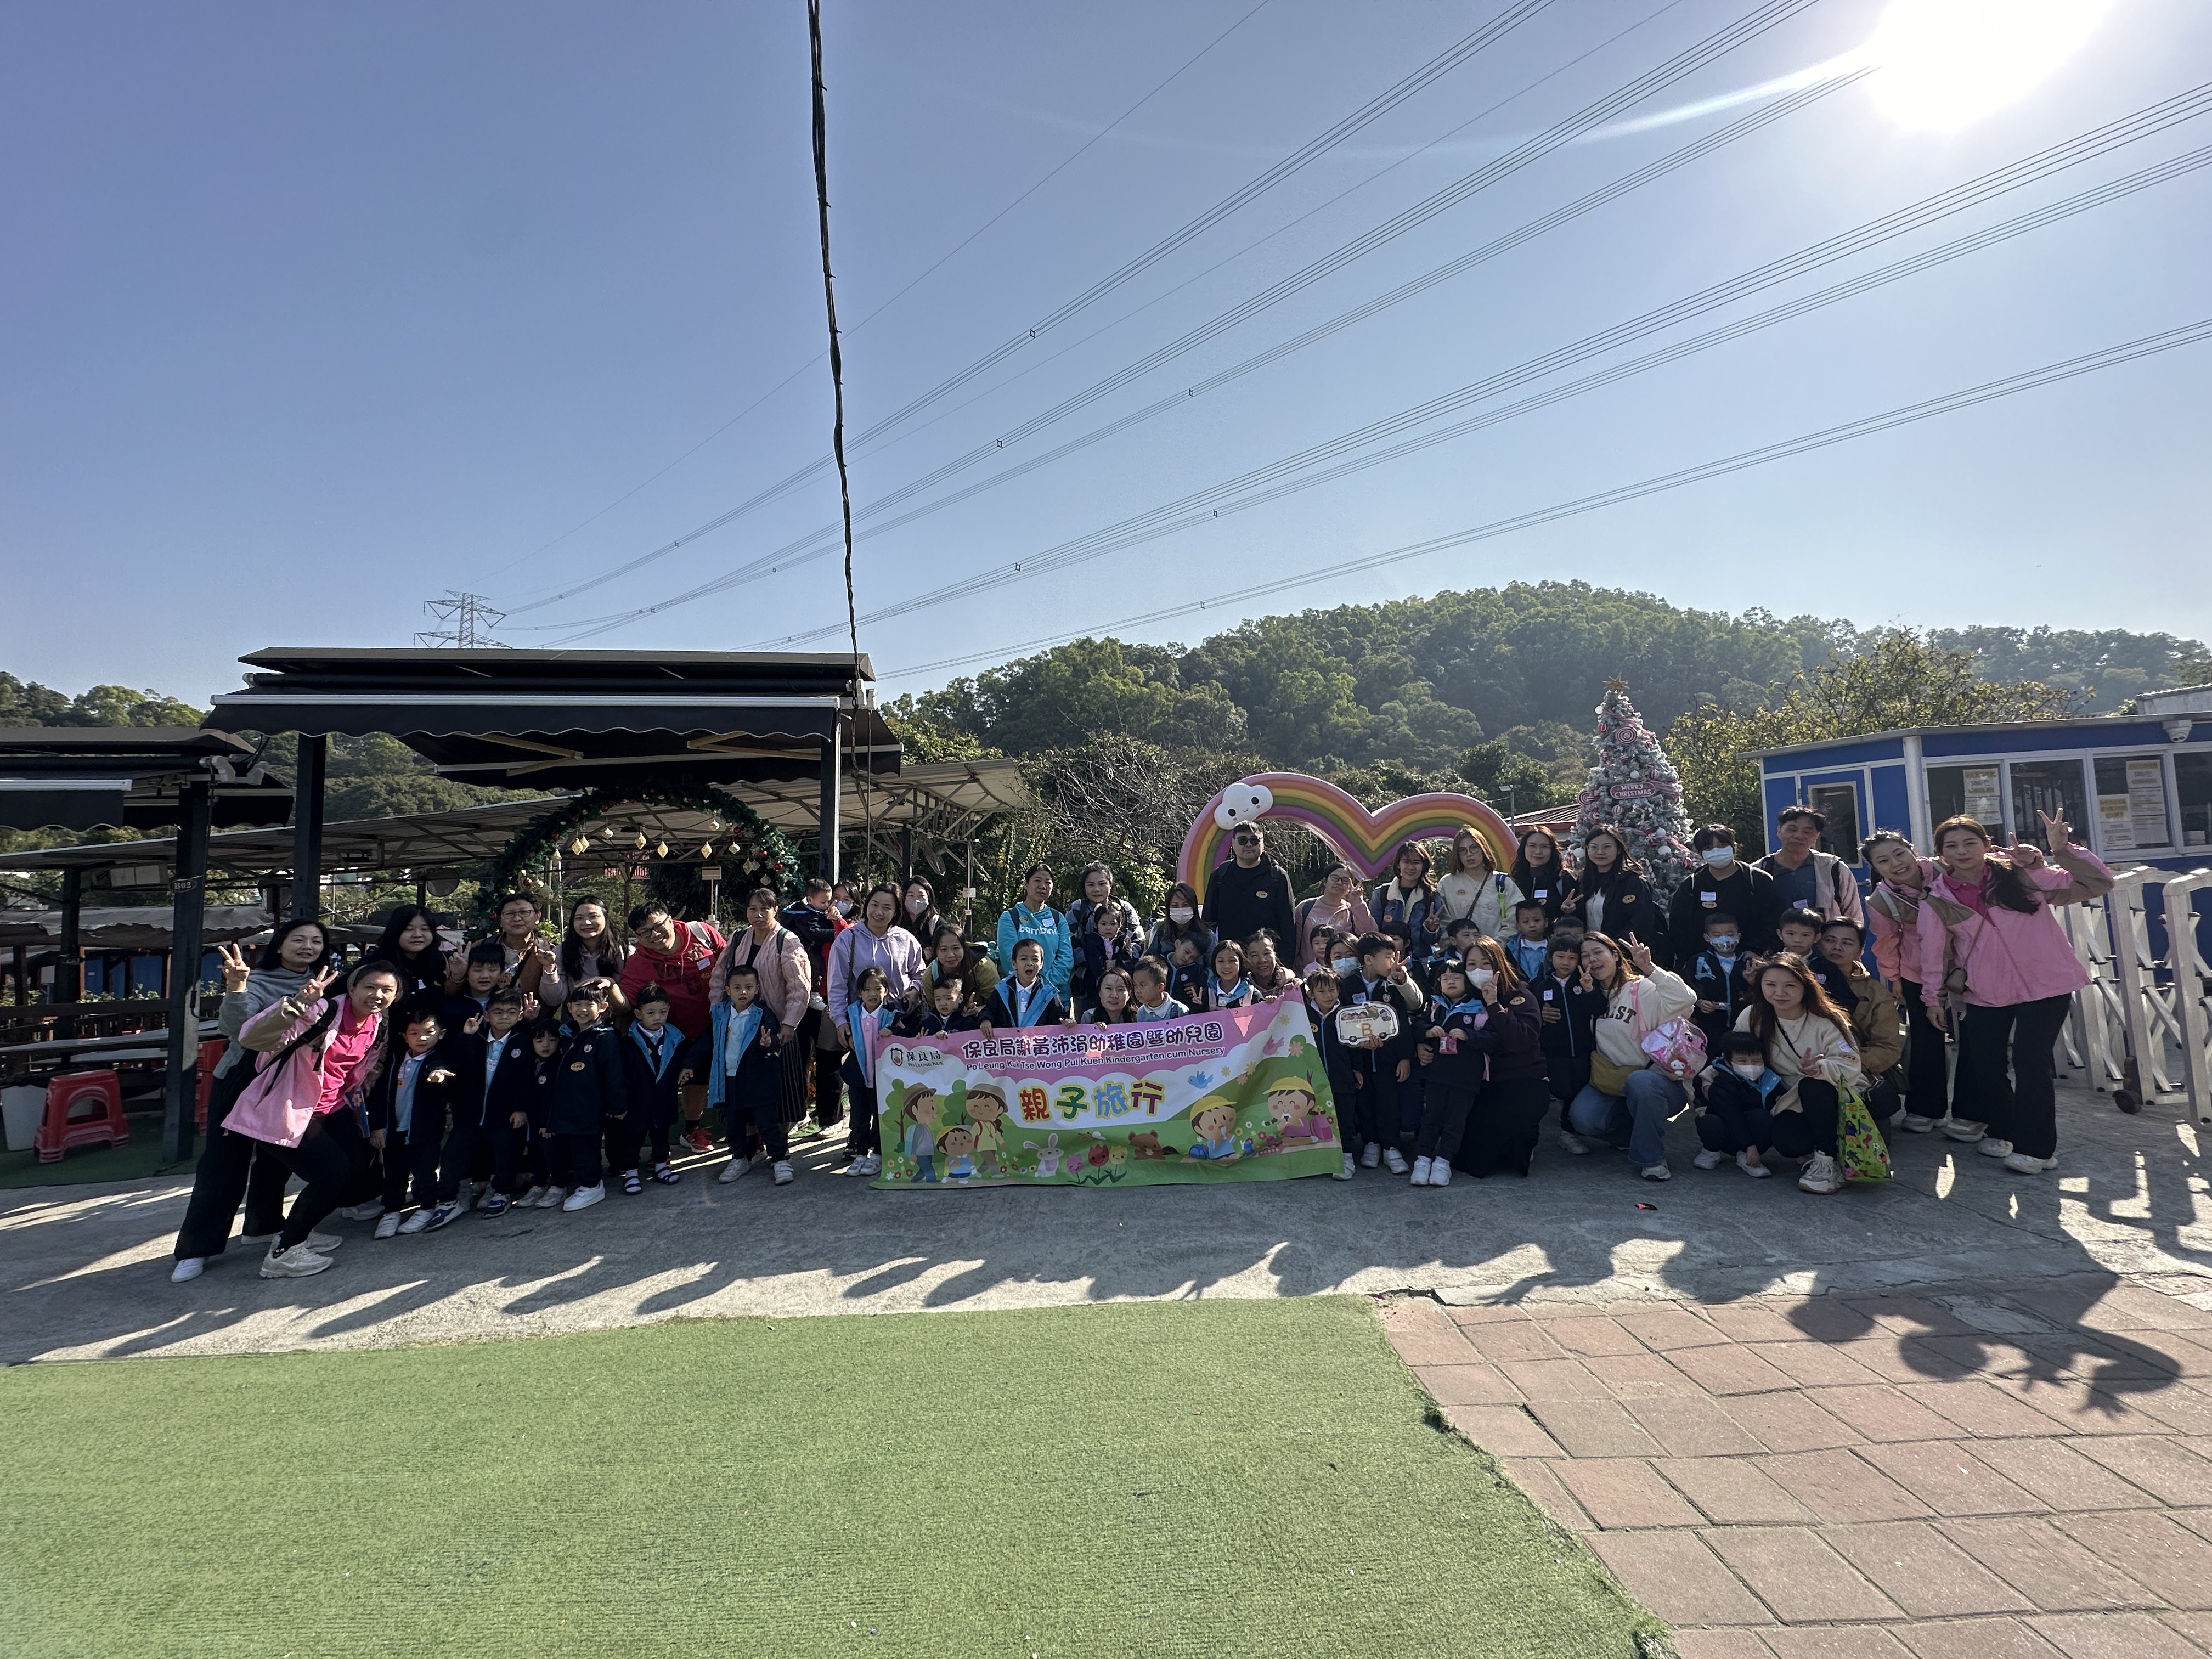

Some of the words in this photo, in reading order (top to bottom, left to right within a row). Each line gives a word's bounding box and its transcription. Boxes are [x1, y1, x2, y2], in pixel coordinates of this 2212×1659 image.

[1615, 789, 1652, 798] CHRISTMAS
[1019, 924, 1057, 935] bambini
[1361, 1023, 1372, 1036] B
[906, 1051, 941, 1062] 保良局
[979, 1062, 1005, 1070] Leung
[1036, 1061, 1062, 1070] Wong
[1081, 1057, 1104, 1066] Kuen
[1105, 1052, 1165, 1064] Kindergarten
[1188, 1047, 1224, 1057] Nursery
[1019, 1082, 1163, 1121] 親子旅行
